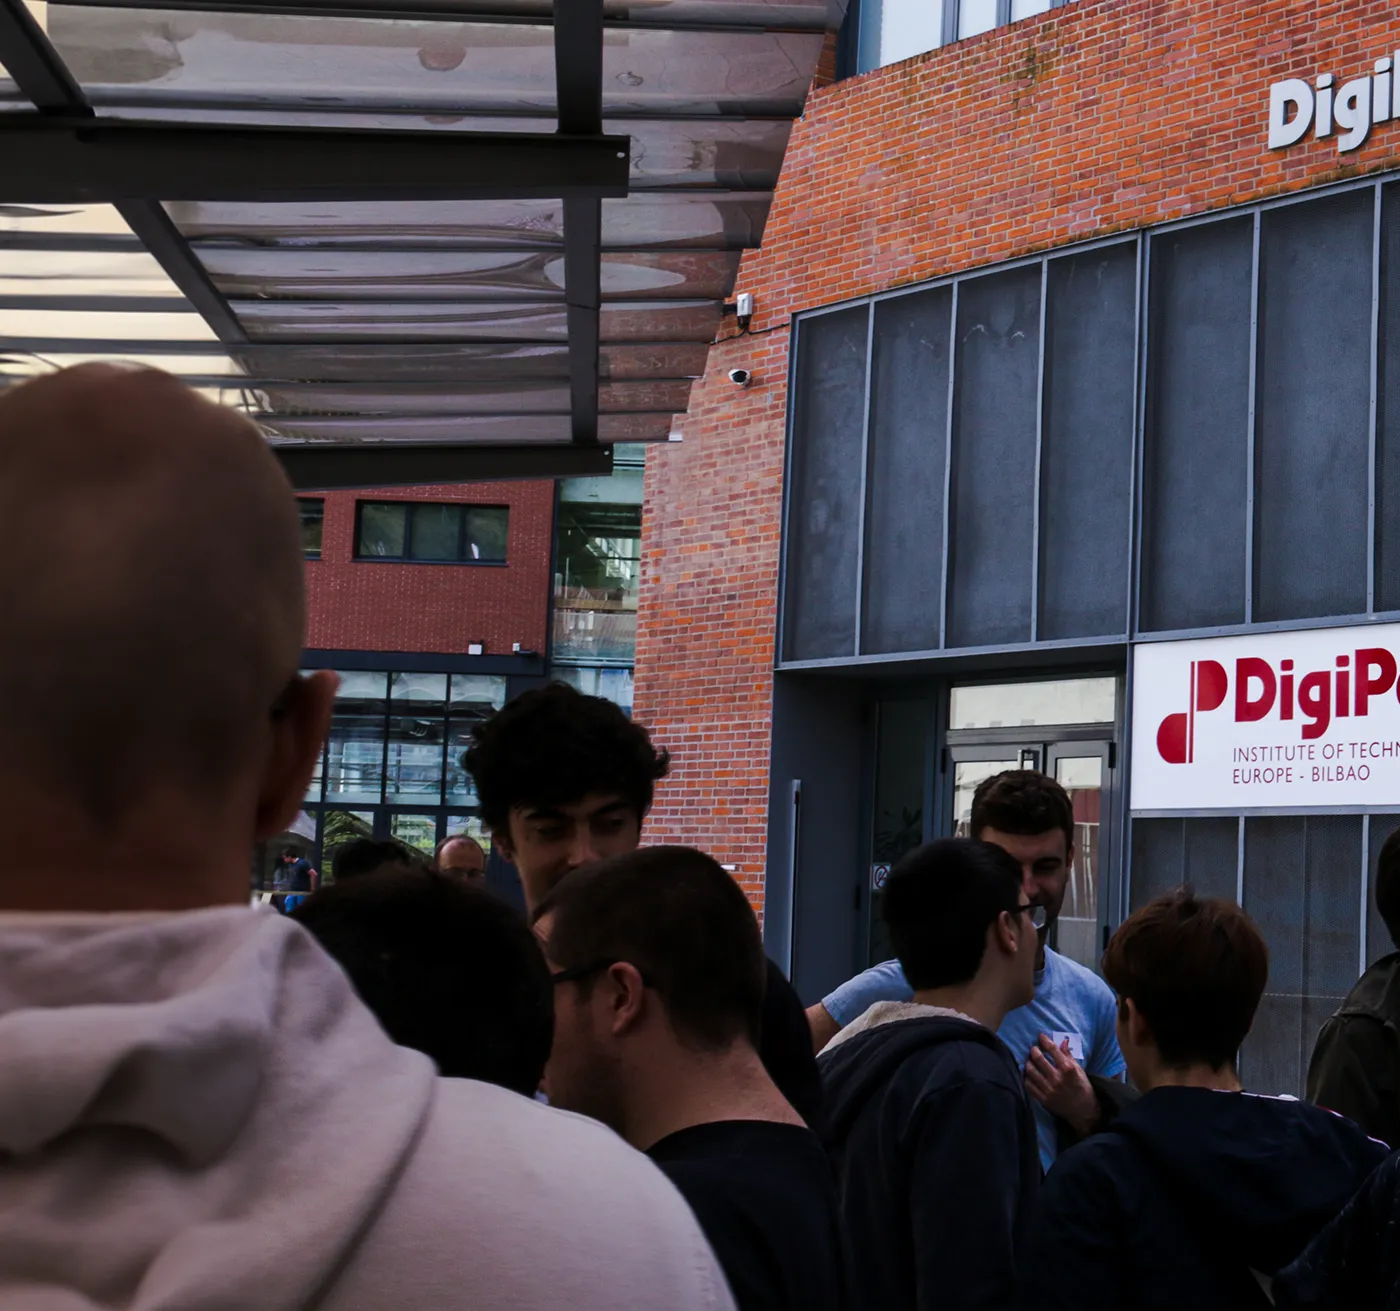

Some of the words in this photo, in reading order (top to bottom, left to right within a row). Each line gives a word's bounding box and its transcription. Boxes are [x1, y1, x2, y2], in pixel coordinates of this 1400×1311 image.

[1232, 743, 1316, 763] INSTITUTE
[1322, 742, 1345, 760] OF
[1232, 767, 1293, 785] EUROPE
[1311, 764, 1371, 783] BILBAO
